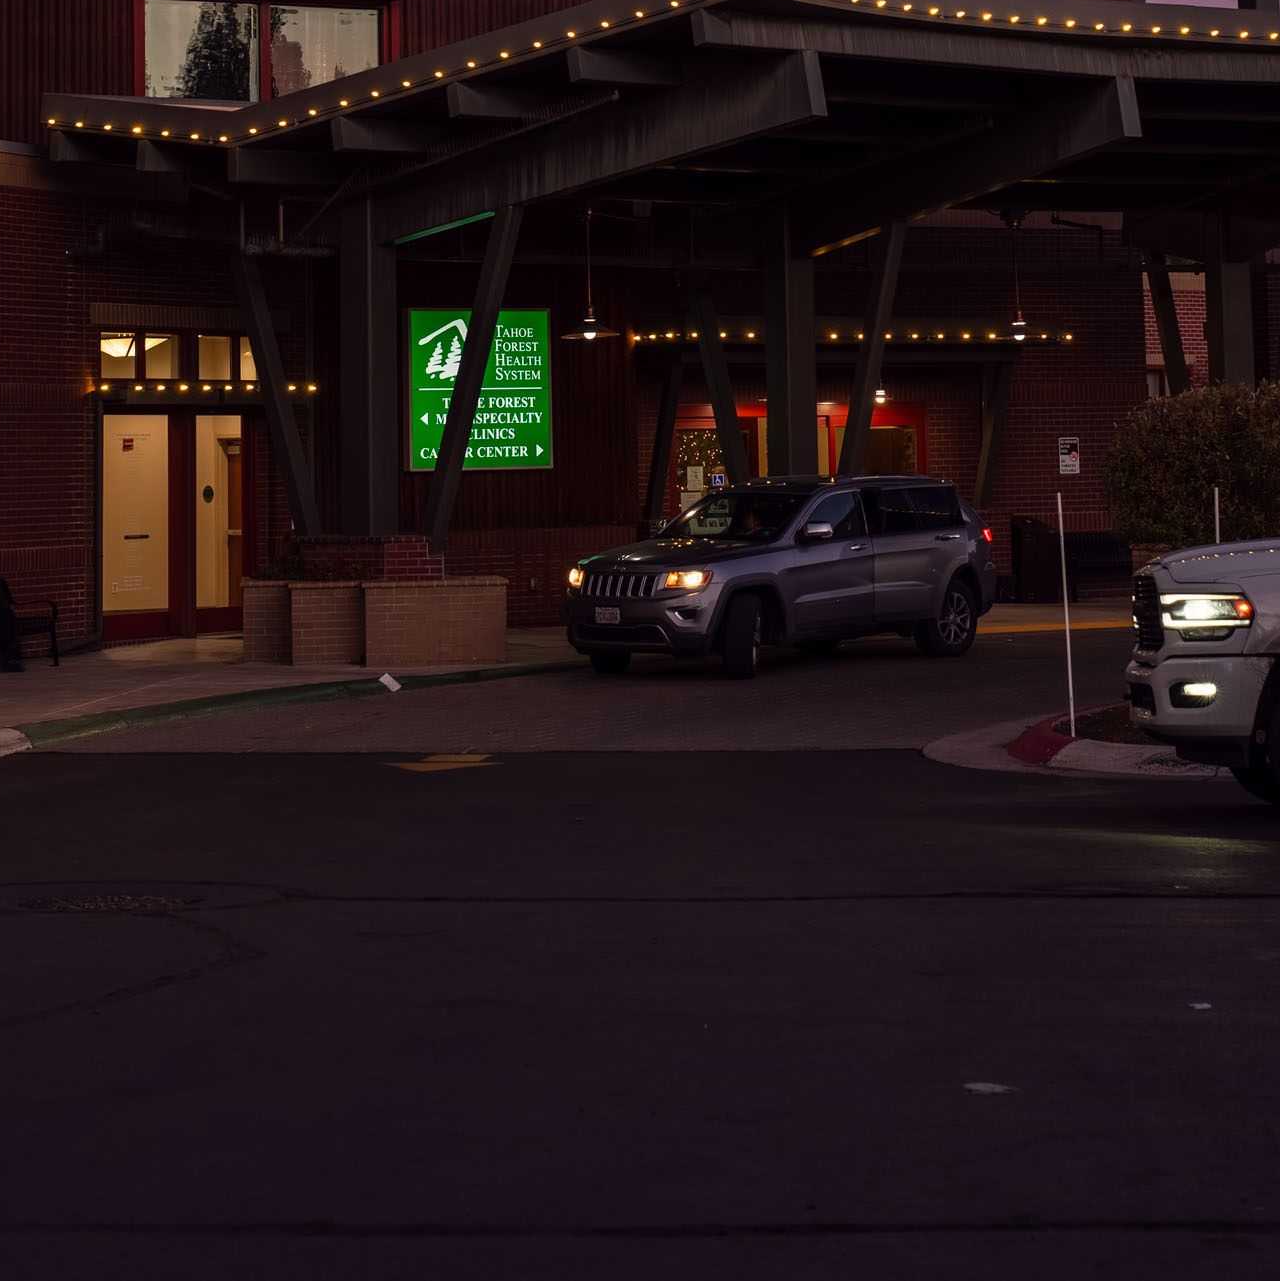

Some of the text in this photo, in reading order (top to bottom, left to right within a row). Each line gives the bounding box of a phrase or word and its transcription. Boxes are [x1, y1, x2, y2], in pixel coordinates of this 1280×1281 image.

[495, 324, 534, 338] TAHOE
[495, 339, 539, 352] FOREST
[495, 353, 542, 366] HEALTH
[495, 367, 541, 381] SYSTEM
[488, 396, 536, 409] FOREST
[435, 412, 543, 425] MSPECIALTY
[420, 445, 529, 459] CAR CENTER
